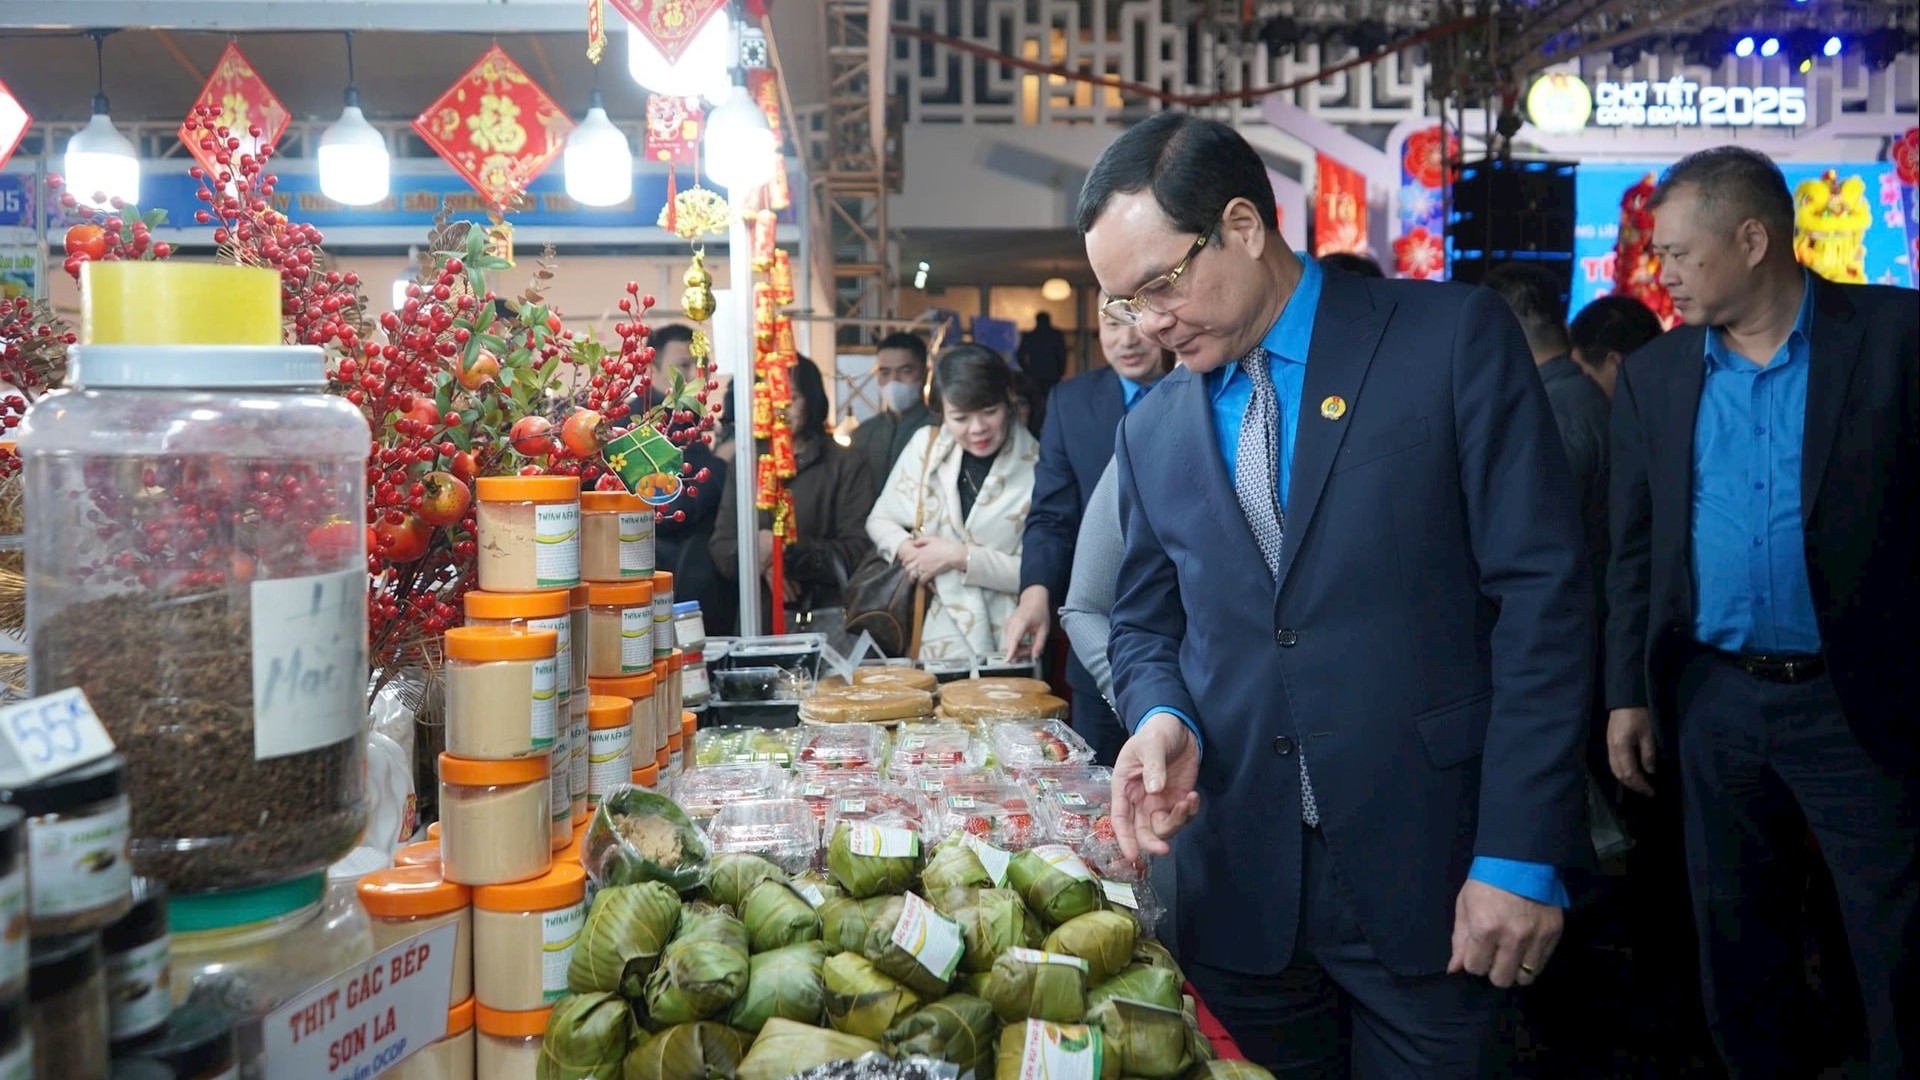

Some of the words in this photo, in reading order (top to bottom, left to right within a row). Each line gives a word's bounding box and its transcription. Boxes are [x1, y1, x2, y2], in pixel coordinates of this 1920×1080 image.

[1653, 75, 1698, 106] TẾT
[1700, 86, 1807, 125] 2025
[466, 93, 527, 153] 福
[289, 989, 340, 1044] THỊT
[346, 962, 384, 1010] GÁC
[390, 939, 430, 985] BẾP
[373, 1005, 396, 1044] LA
[372, 1037, 408, 1072] OCOP
